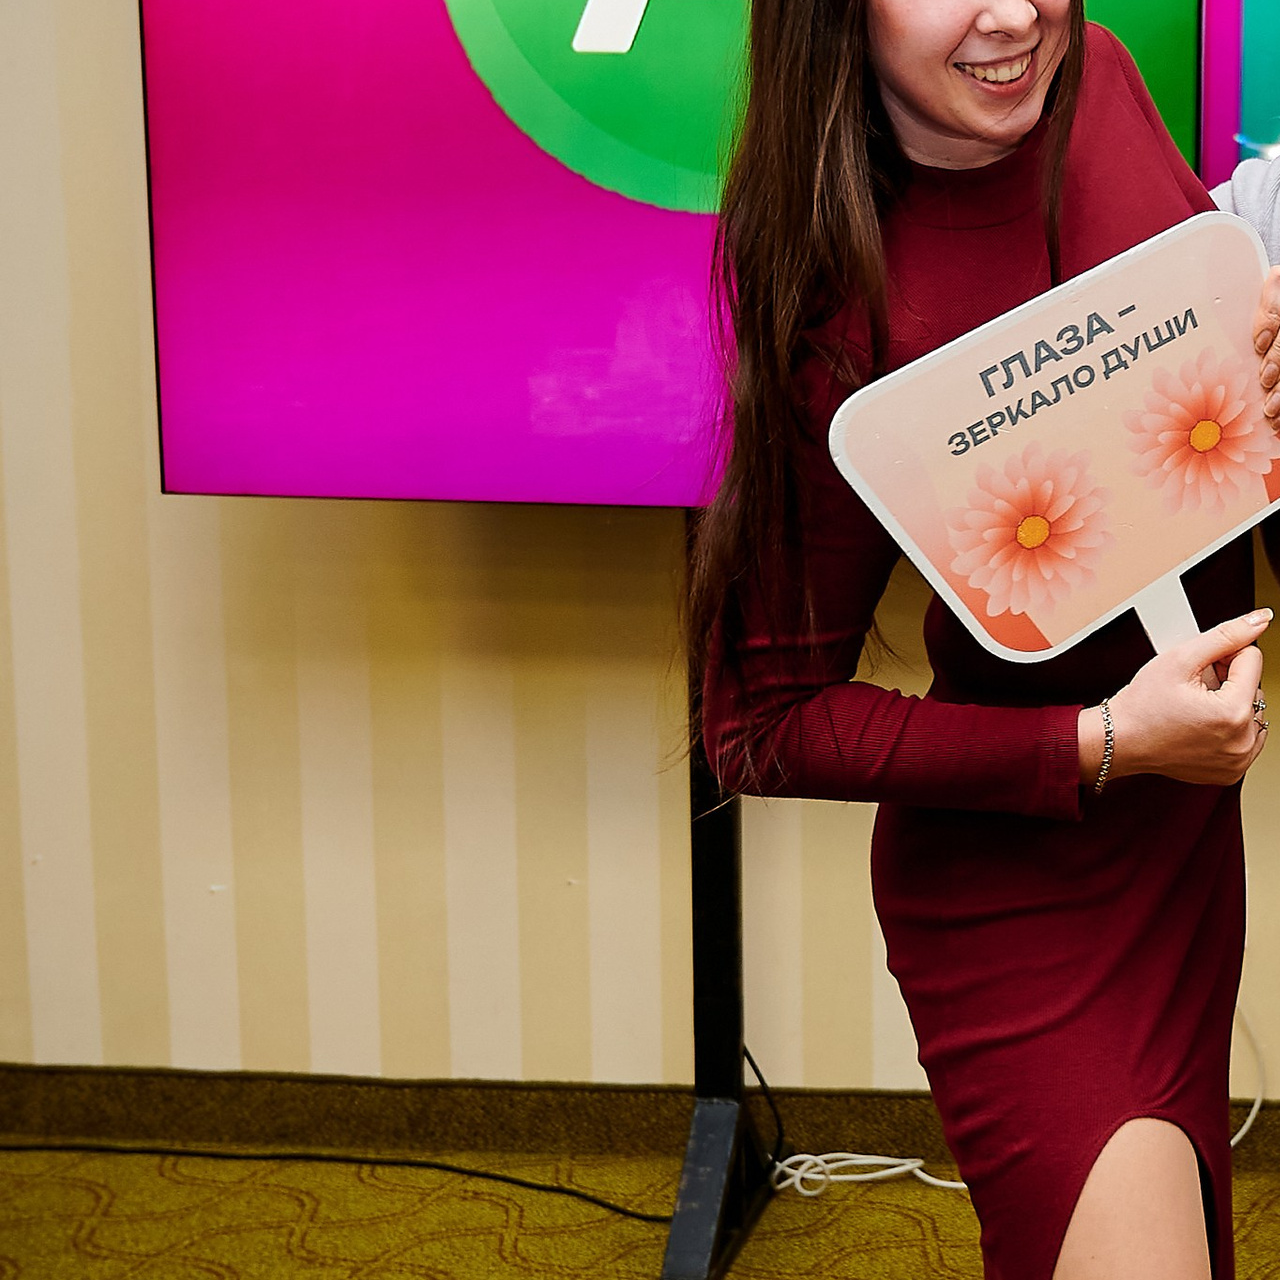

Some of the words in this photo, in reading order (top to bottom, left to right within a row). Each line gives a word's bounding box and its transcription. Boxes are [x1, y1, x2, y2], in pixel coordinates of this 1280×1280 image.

[948, 365, 1096, 457] ЗЕРКАЛО
[1102, 307, 1200, 380] ДУШИ
[979, 311, 1115, 398] ГЛАЗА
